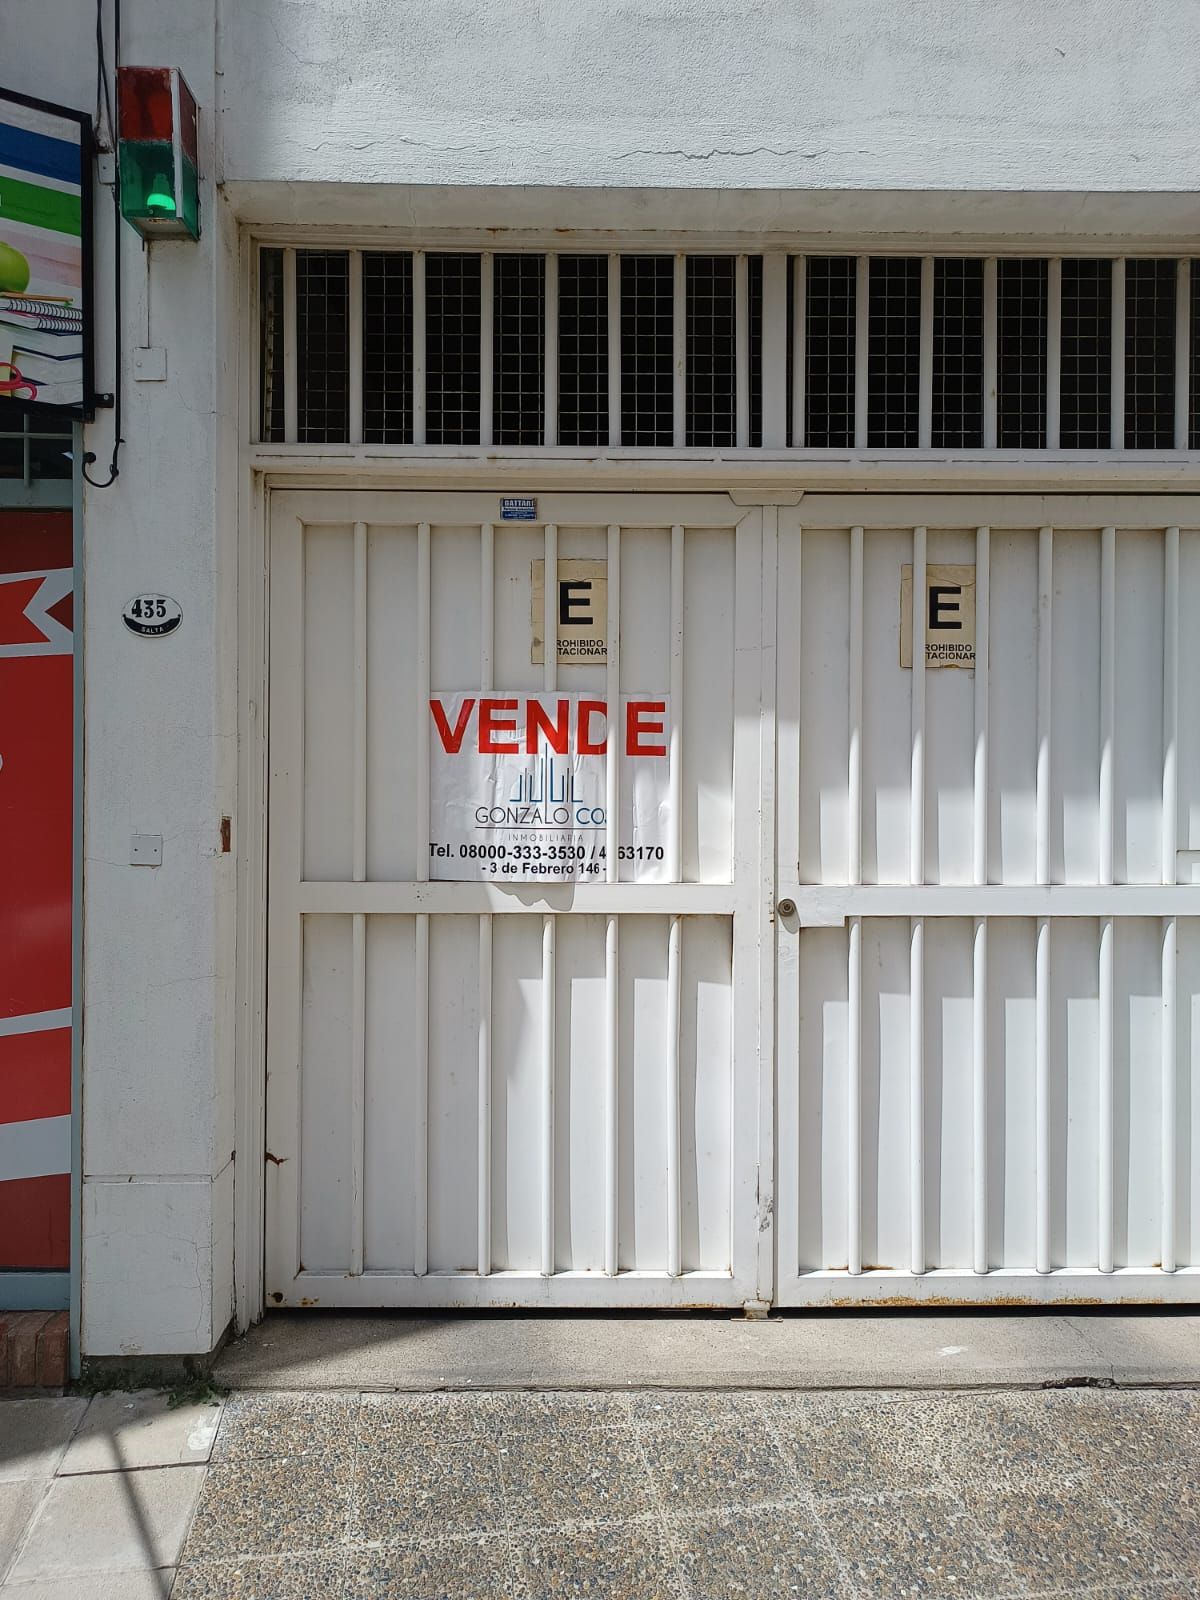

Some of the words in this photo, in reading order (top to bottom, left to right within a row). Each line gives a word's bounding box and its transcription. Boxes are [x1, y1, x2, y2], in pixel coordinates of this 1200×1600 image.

[131, 599, 166, 618] 435
[560, 582, 593, 624] E
[929, 586, 962, 629] E
[557, 639, 604, 647] ROHIBIDO
[925, 643, 972, 652] ROHIBIDO
[557, 647, 607, 655] TACIONAR
[926, 652, 976, 660] TACIONAR
[429, 699, 666, 756] VENDE
[475, 806, 569, 824] GONZALO
[576, 807, 607, 825] CO
[508, 833, 584, 842] INMOBILIARIA
[429, 843, 454, 858] Tel.
[459, 844, 586, 860] 08000-333-3530
[598, 845, 664, 860] 463170
[490, 863, 497, 873] 3
[501, 863, 518, 874] de
[522, 863, 574, 874] Febrero
[578, 863, 600, 874] 146
